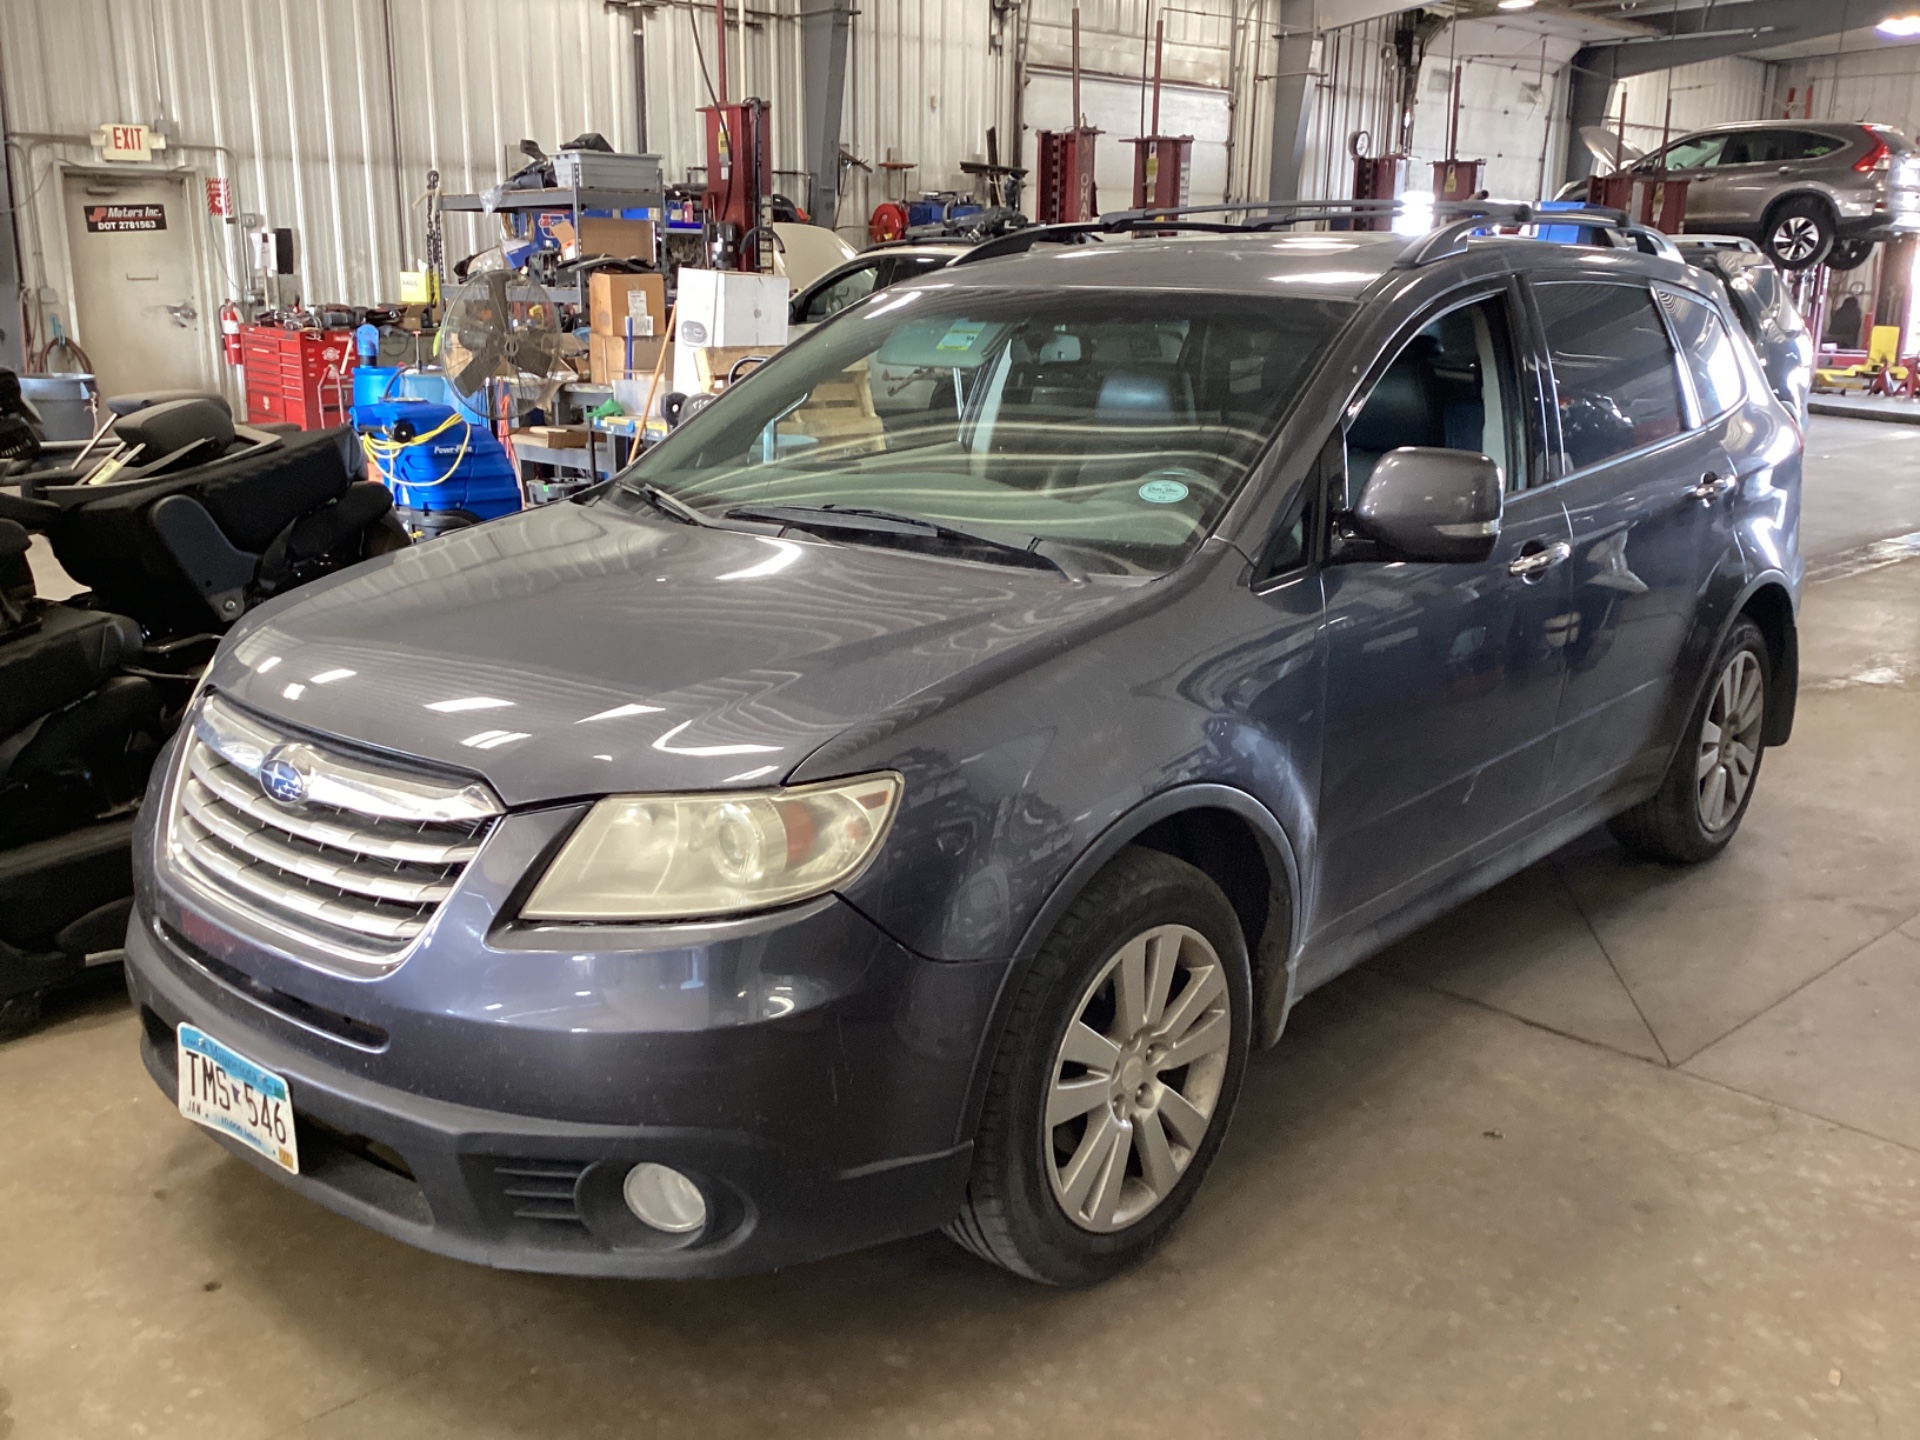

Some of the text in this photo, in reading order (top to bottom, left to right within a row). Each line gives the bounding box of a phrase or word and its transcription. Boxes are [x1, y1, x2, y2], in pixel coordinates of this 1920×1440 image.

[113, 127, 142, 150] EXIT
[108, 207, 143, 218] Motors
[145, 206, 162, 217] Inc.
[98, 221, 116, 230] DOT
[186, 1050, 287, 1145] TMS 546
[186, 1099, 201, 1116] JAN
